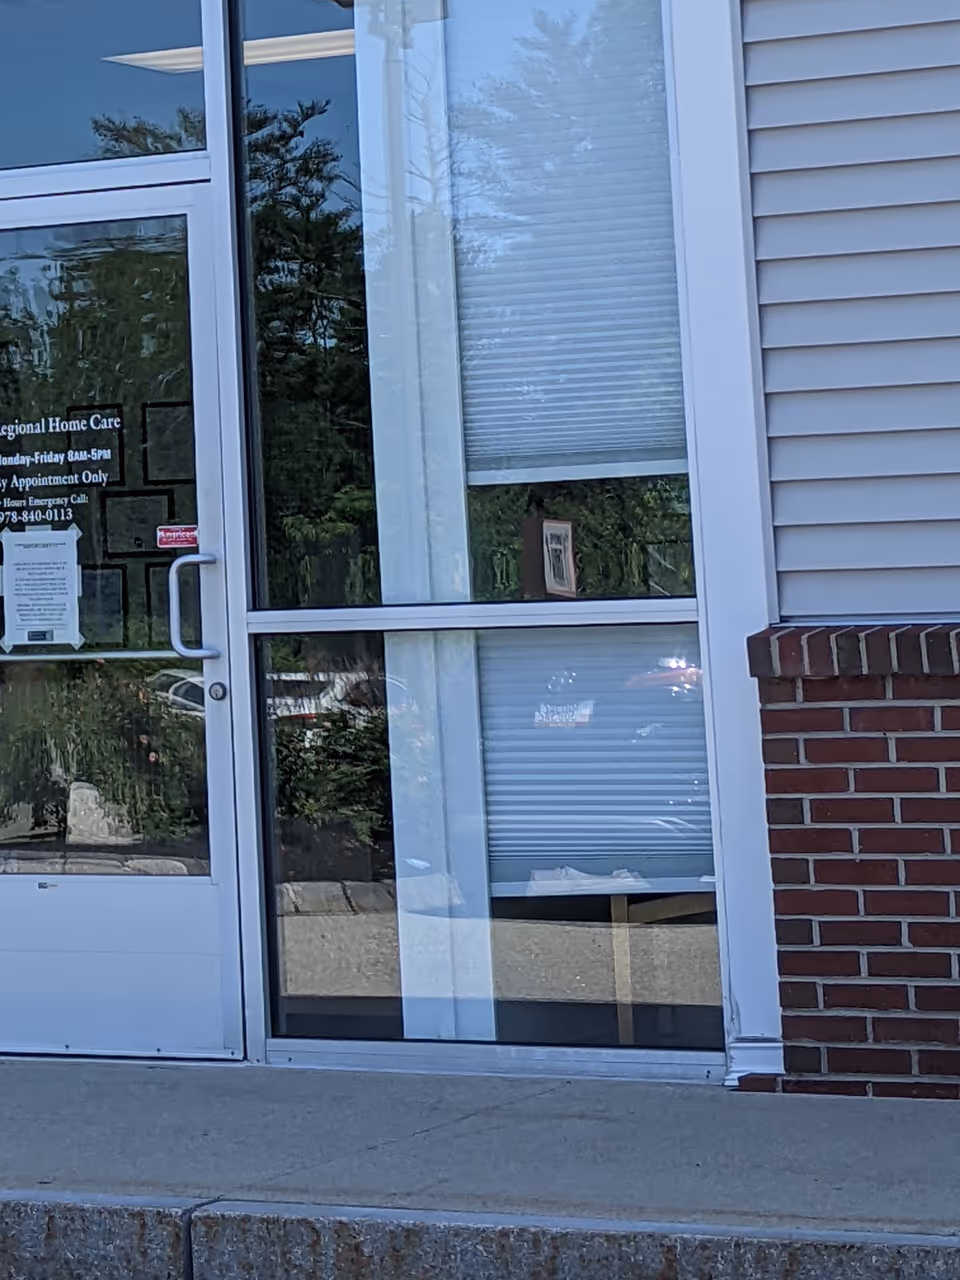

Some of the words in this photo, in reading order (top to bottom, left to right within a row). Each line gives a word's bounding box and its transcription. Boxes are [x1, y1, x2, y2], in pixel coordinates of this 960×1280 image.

[48, 417, 87, 433] Home
[90, 414, 121, 430] Care
[67, 448, 112, 462] 8AM-5PM
[10, 473, 79, 491] Appointment
[82, 470, 109, 487] Only
[3, 497, 26, 508] Hours
[28, 496, 69, 508] Emergency
[70, 494, 89, 504] Call:
